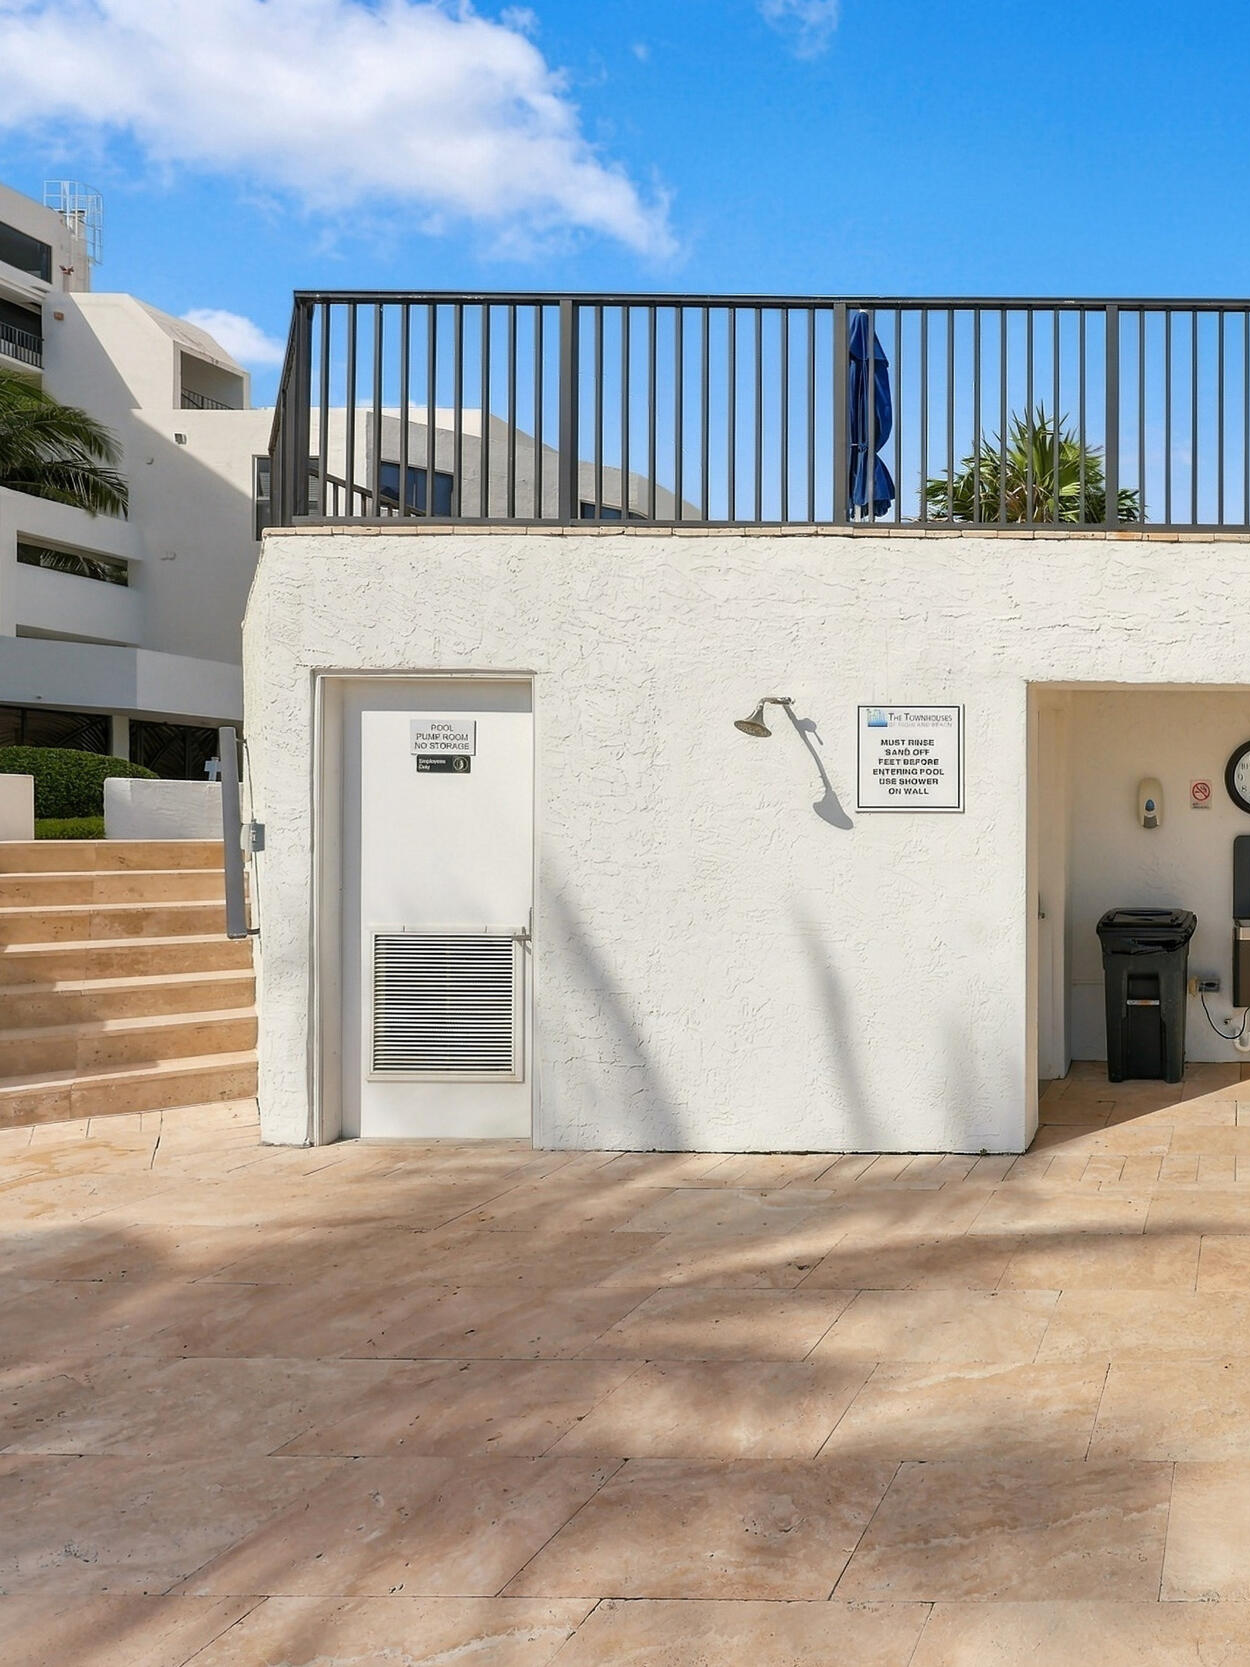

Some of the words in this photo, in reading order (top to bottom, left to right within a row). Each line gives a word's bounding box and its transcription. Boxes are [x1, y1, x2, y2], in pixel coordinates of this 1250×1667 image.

[430, 724, 454, 732] POOL
[416, 732, 440, 741] PUMP
[442, 732, 468, 741] ROOM
[414, 742, 428, 750] NO
[430, 742, 470, 750] STORAGE
